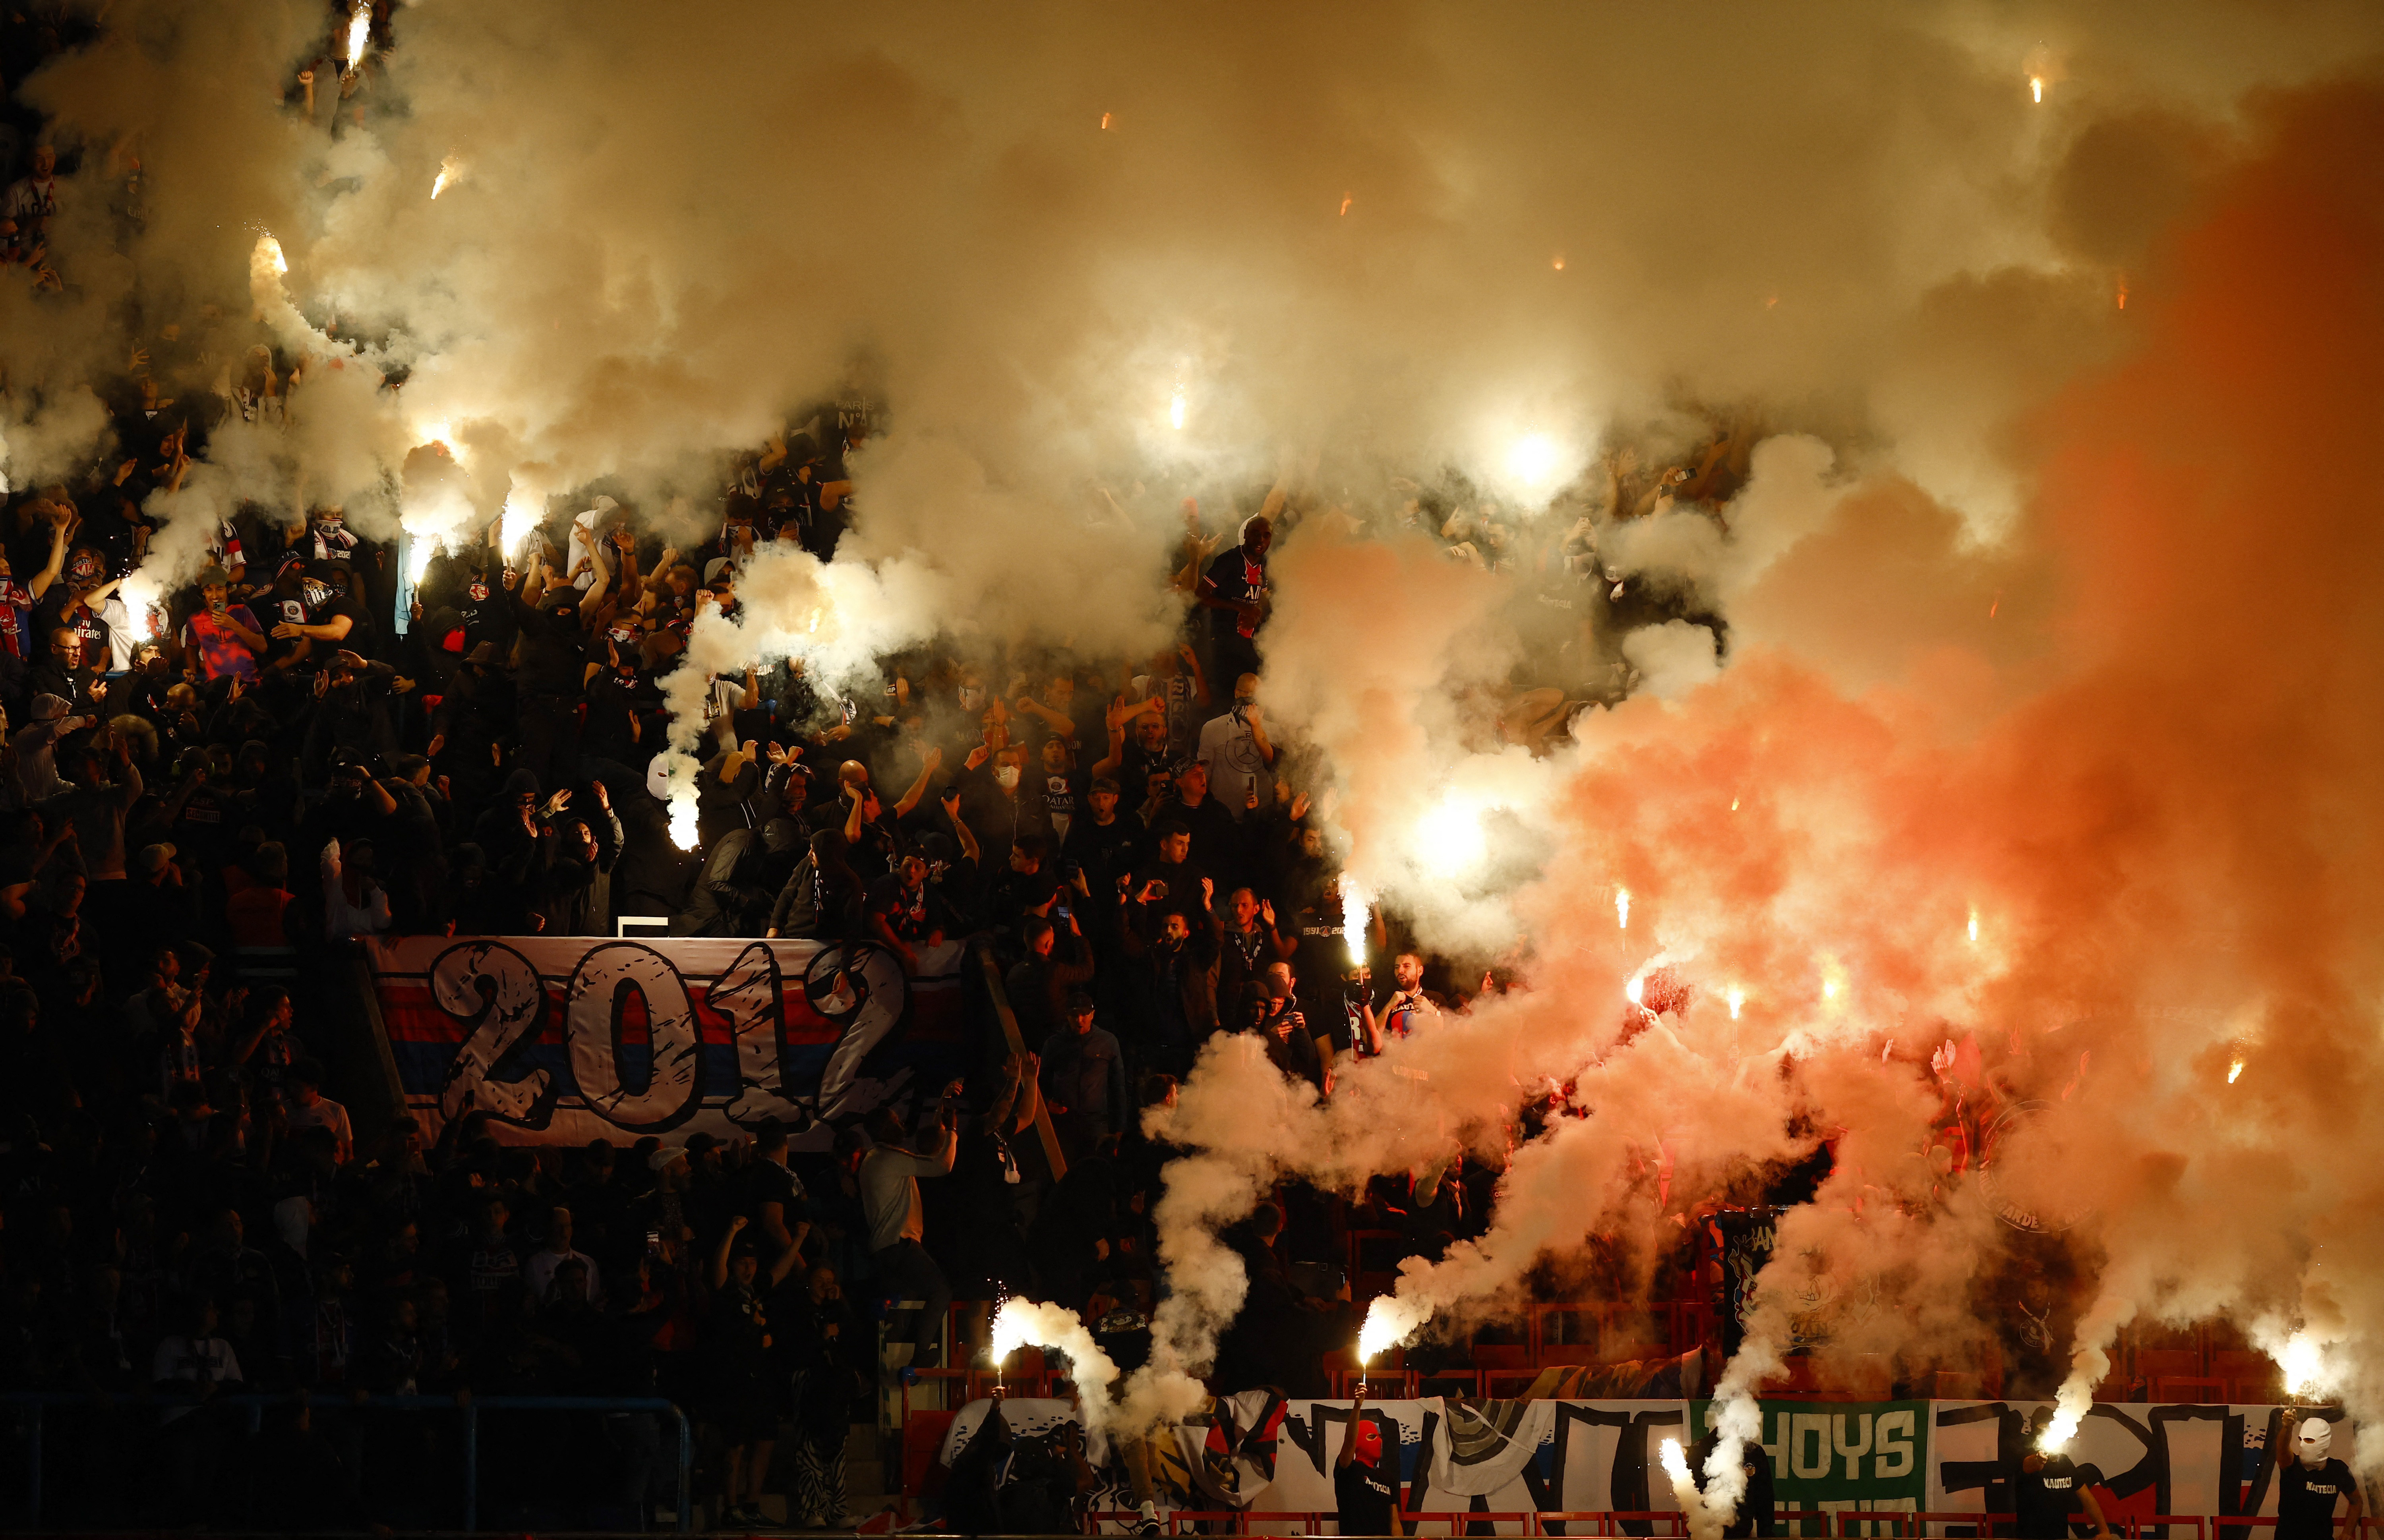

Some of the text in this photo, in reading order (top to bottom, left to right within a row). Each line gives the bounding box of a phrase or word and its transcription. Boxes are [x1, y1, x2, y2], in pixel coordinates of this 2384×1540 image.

[74, 626, 101, 640] irates
[428, 940, 921, 1134] 2012
[1703, 1410, 1915, 1480] HOYS
[2043, 1476, 2072, 1489] NAUTECI
